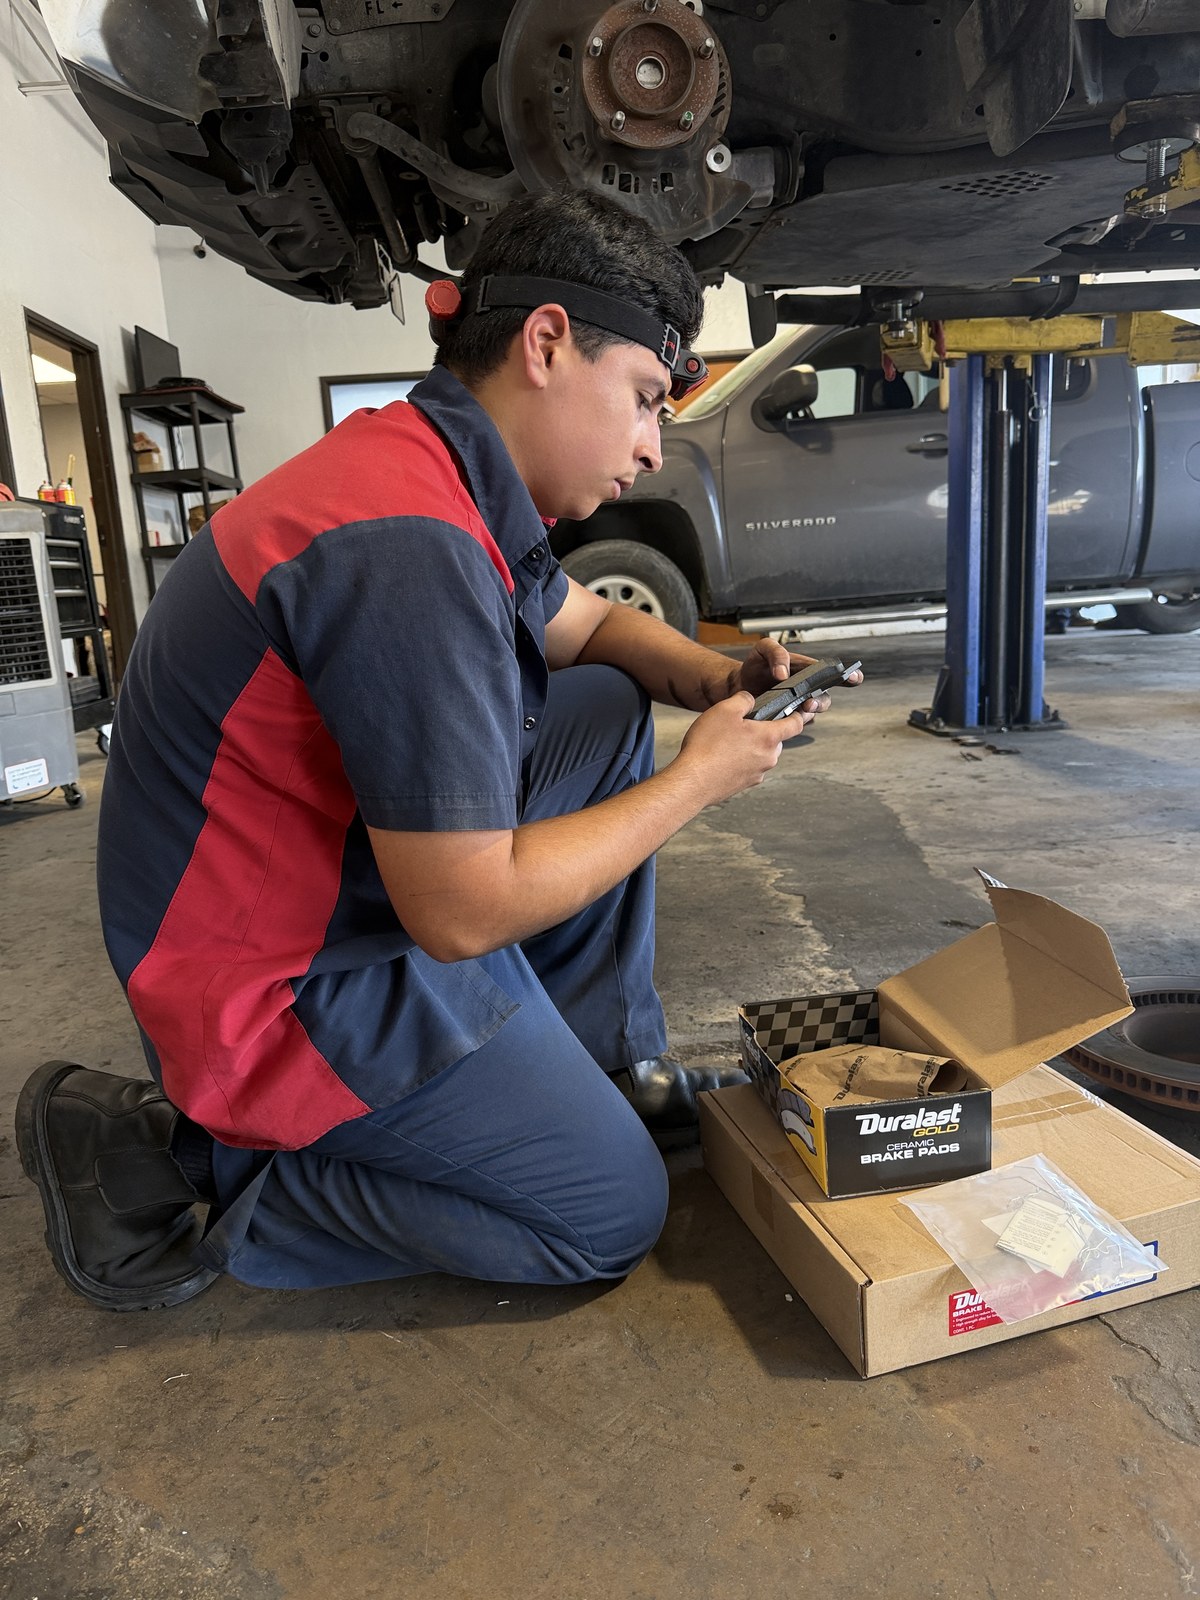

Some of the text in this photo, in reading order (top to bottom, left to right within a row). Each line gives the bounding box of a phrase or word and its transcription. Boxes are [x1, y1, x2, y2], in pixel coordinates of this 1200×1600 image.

[745, 516, 836, 532] SILVERADO
[856, 1103, 962, 1136] Duralast
[913, 1123, 959, 1138] GOLD
[886, 1138, 935, 1152] CERAMIC
[860, 1142, 961, 1165] BRAKE PADS
[952, 1304, 983, 1318] BRAKE
